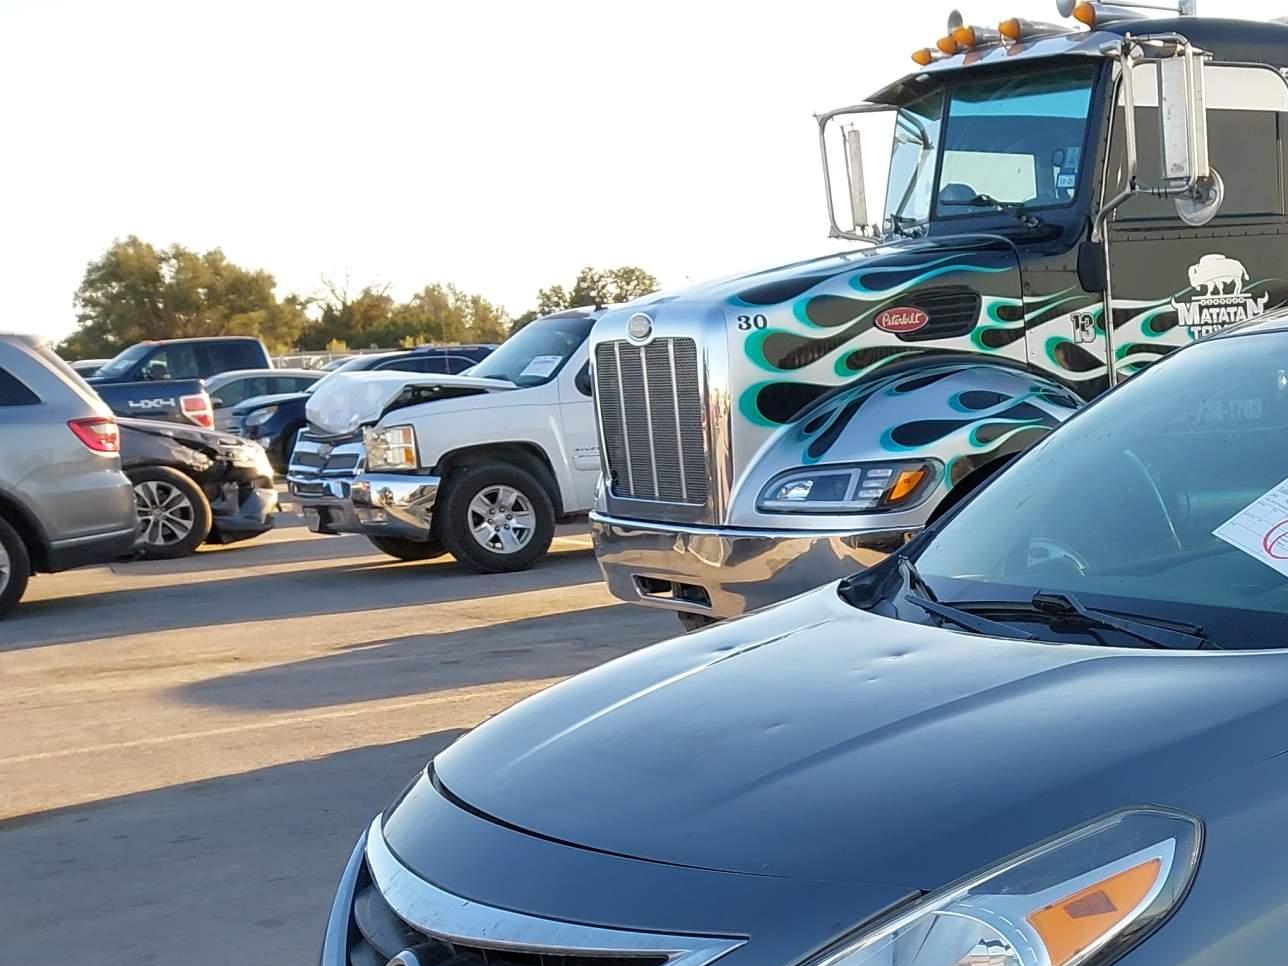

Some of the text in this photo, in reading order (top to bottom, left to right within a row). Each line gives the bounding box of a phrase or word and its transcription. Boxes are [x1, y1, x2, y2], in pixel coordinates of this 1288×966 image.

[737, 314, 767, 330] 30
[881, 312, 922, 327] Peterbilt
[1173, 295, 1267, 327] MATATAN
[1071, 312, 1096, 343] 13
